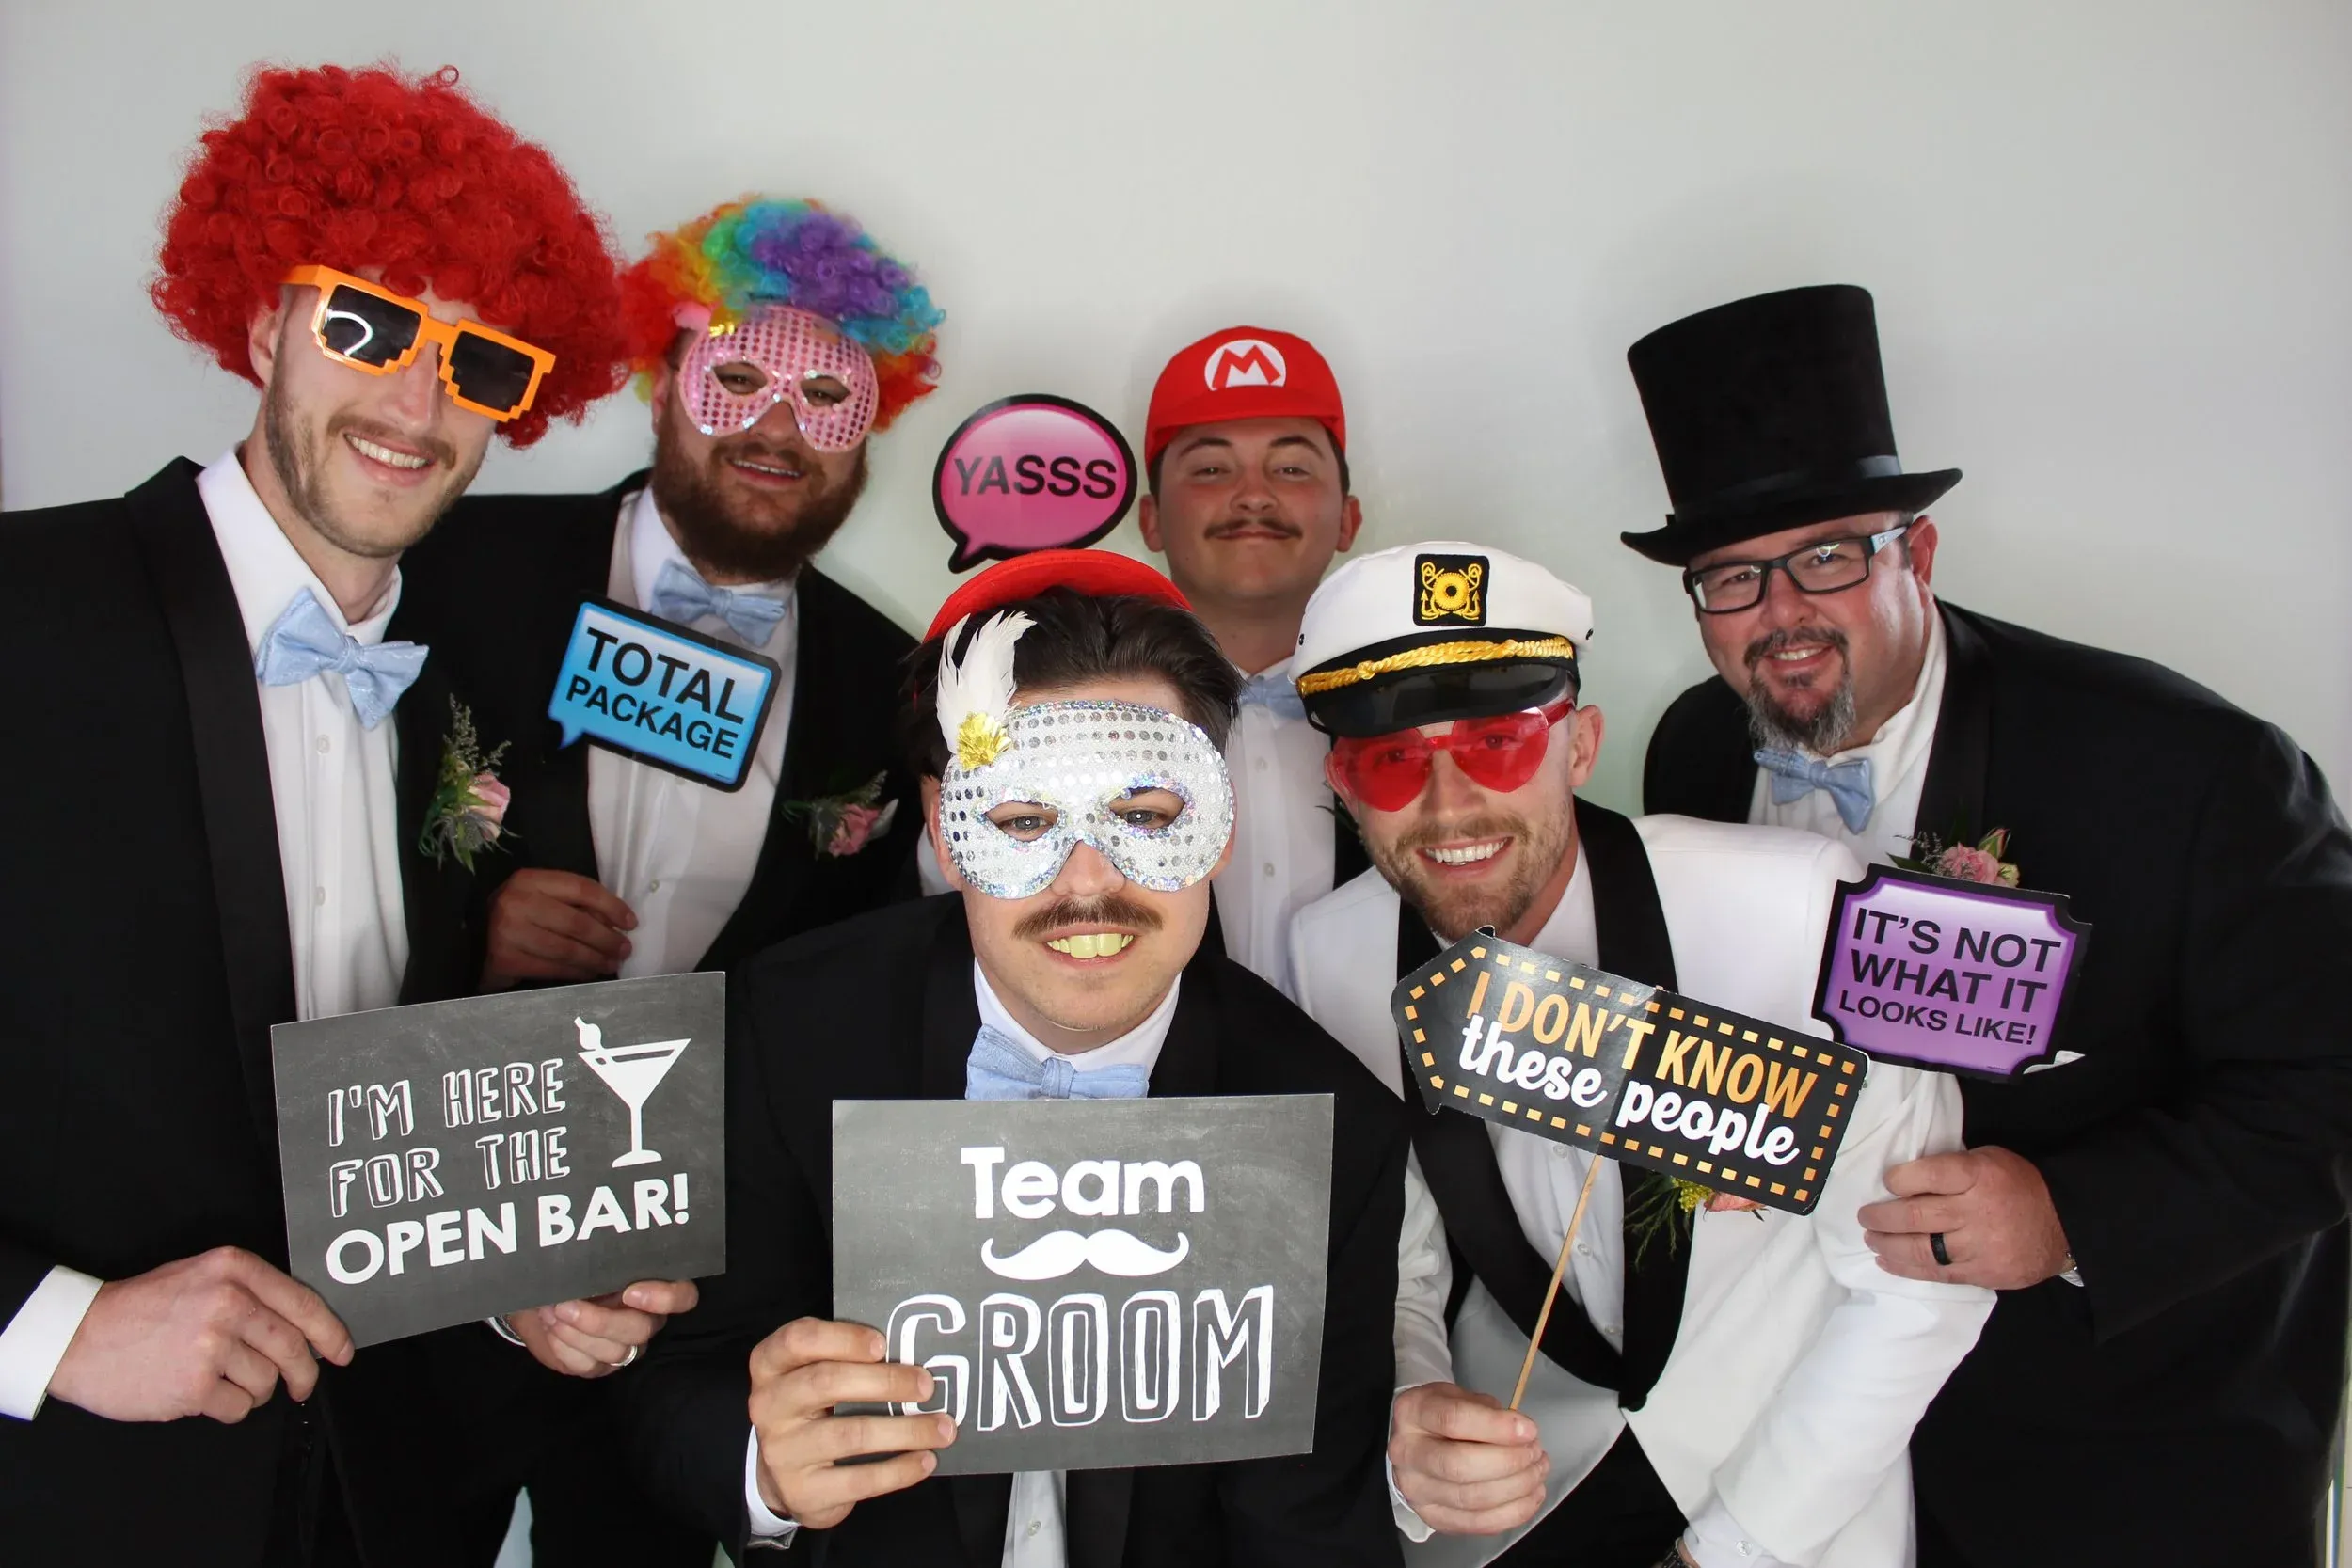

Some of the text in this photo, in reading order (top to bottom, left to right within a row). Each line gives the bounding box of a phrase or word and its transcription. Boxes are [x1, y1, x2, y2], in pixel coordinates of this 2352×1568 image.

[1212, 344, 1281, 388] M
[953, 455, 1117, 499] YASSS
[565, 674, 739, 760] PACKAGE
[587, 626, 744, 725] TOTAL
[1851, 947, 2048, 1013] WHAT IT
[1852, 907, 2061, 973] IT'S NOT
[1466, 971, 1818, 1119] I DON'T KNOW
[1838, 990, 2037, 1046] LOOKS LIKE!
[328, 1057, 566, 1147] I'M HERE
[1458, 1015, 1800, 1165] these people
[329, 1126, 571, 1219] FOR THE
[961, 1146, 1205, 1219] Team
[326, 1172, 690, 1285] OPEN BAR!
[886, 1284, 1274, 1432] GROOM
